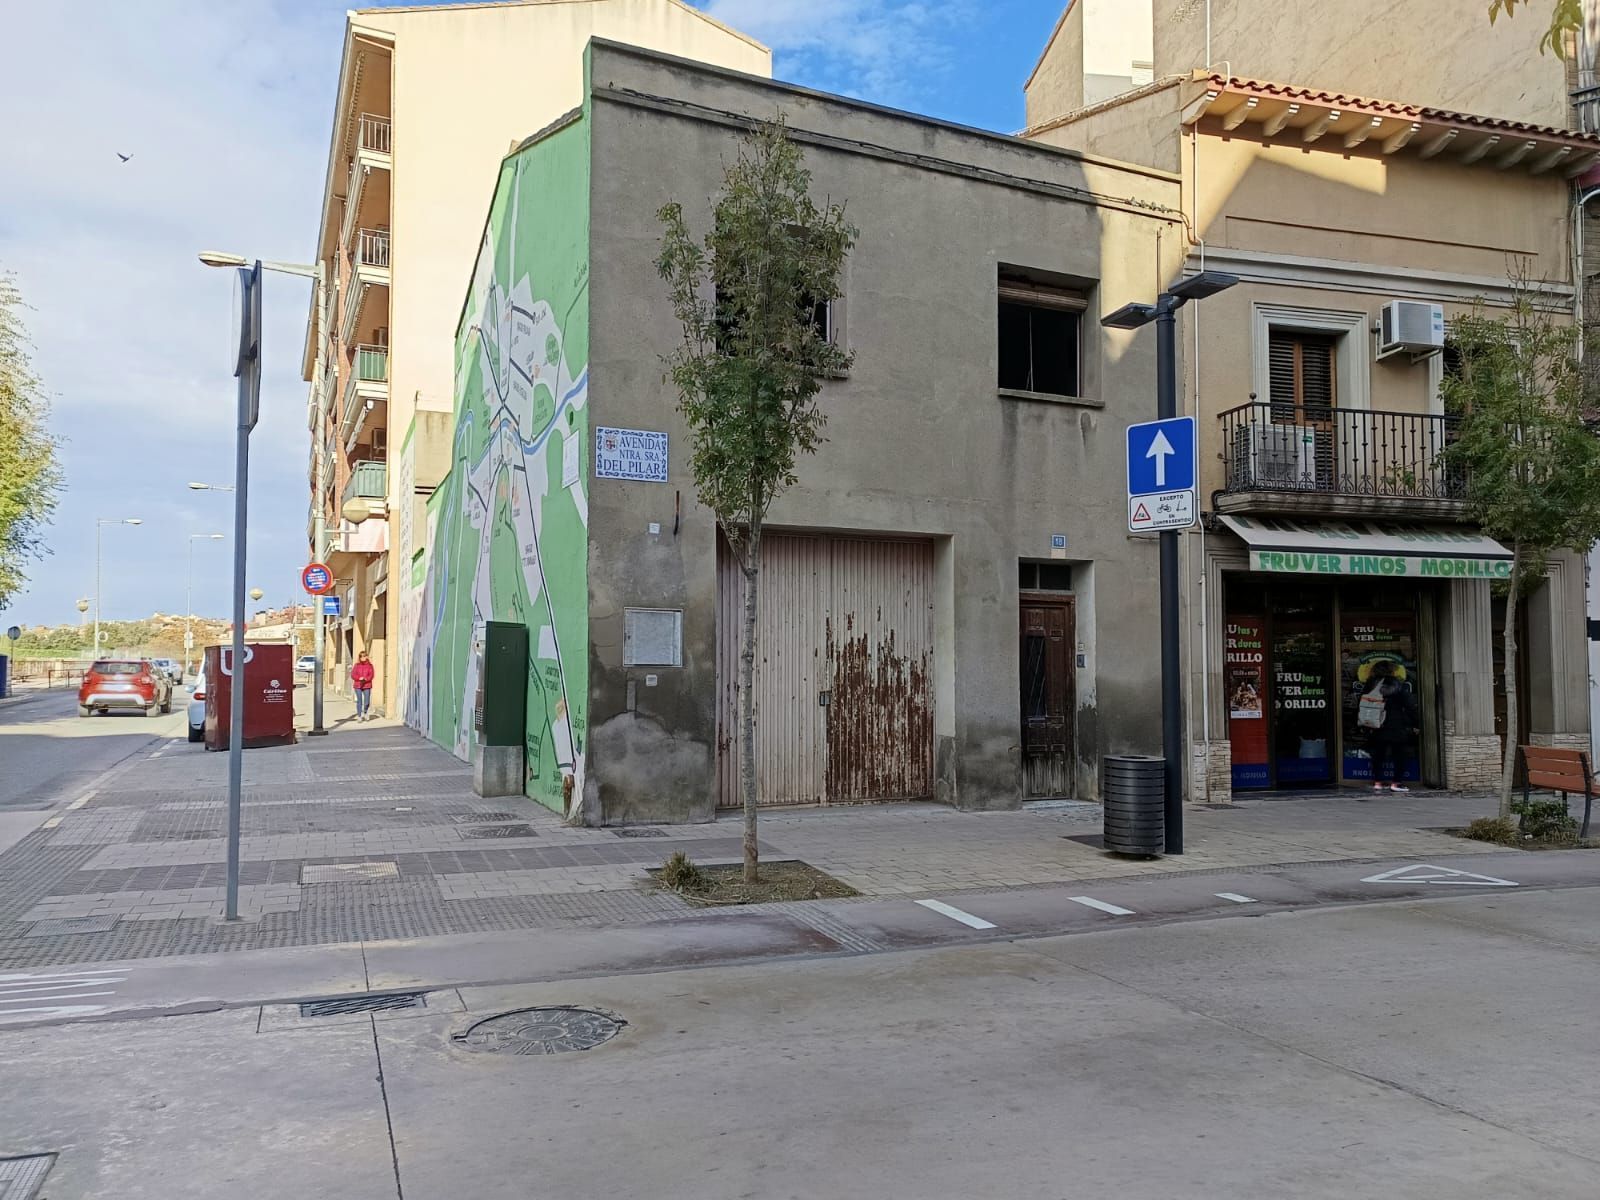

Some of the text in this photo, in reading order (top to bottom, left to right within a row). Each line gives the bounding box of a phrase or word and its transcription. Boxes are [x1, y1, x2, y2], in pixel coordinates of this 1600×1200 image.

[620, 437, 660, 450] AVENIDA
[604, 459, 660, 474] DEL PILAR
[1259, 552, 1509, 577] FRUVER HNOS MORILLO
